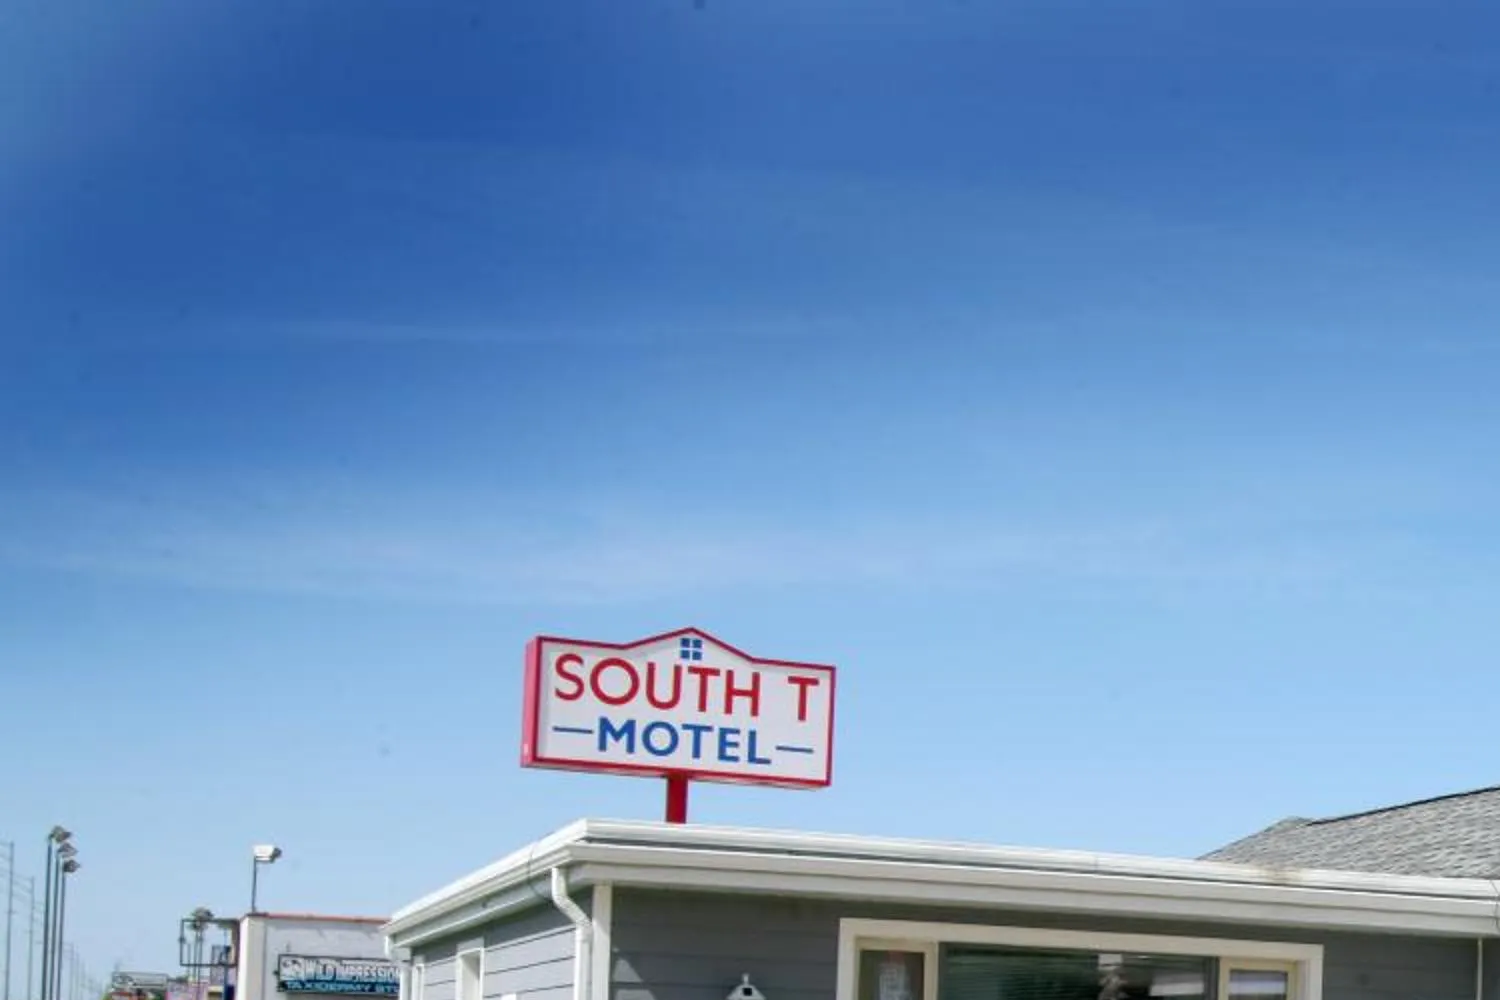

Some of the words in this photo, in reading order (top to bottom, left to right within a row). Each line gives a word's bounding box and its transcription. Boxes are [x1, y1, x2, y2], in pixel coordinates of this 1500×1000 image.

[554, 653, 760, 717] SOUTH
[788, 675, 819, 721] T
[598, 716, 771, 764] MOTEL
